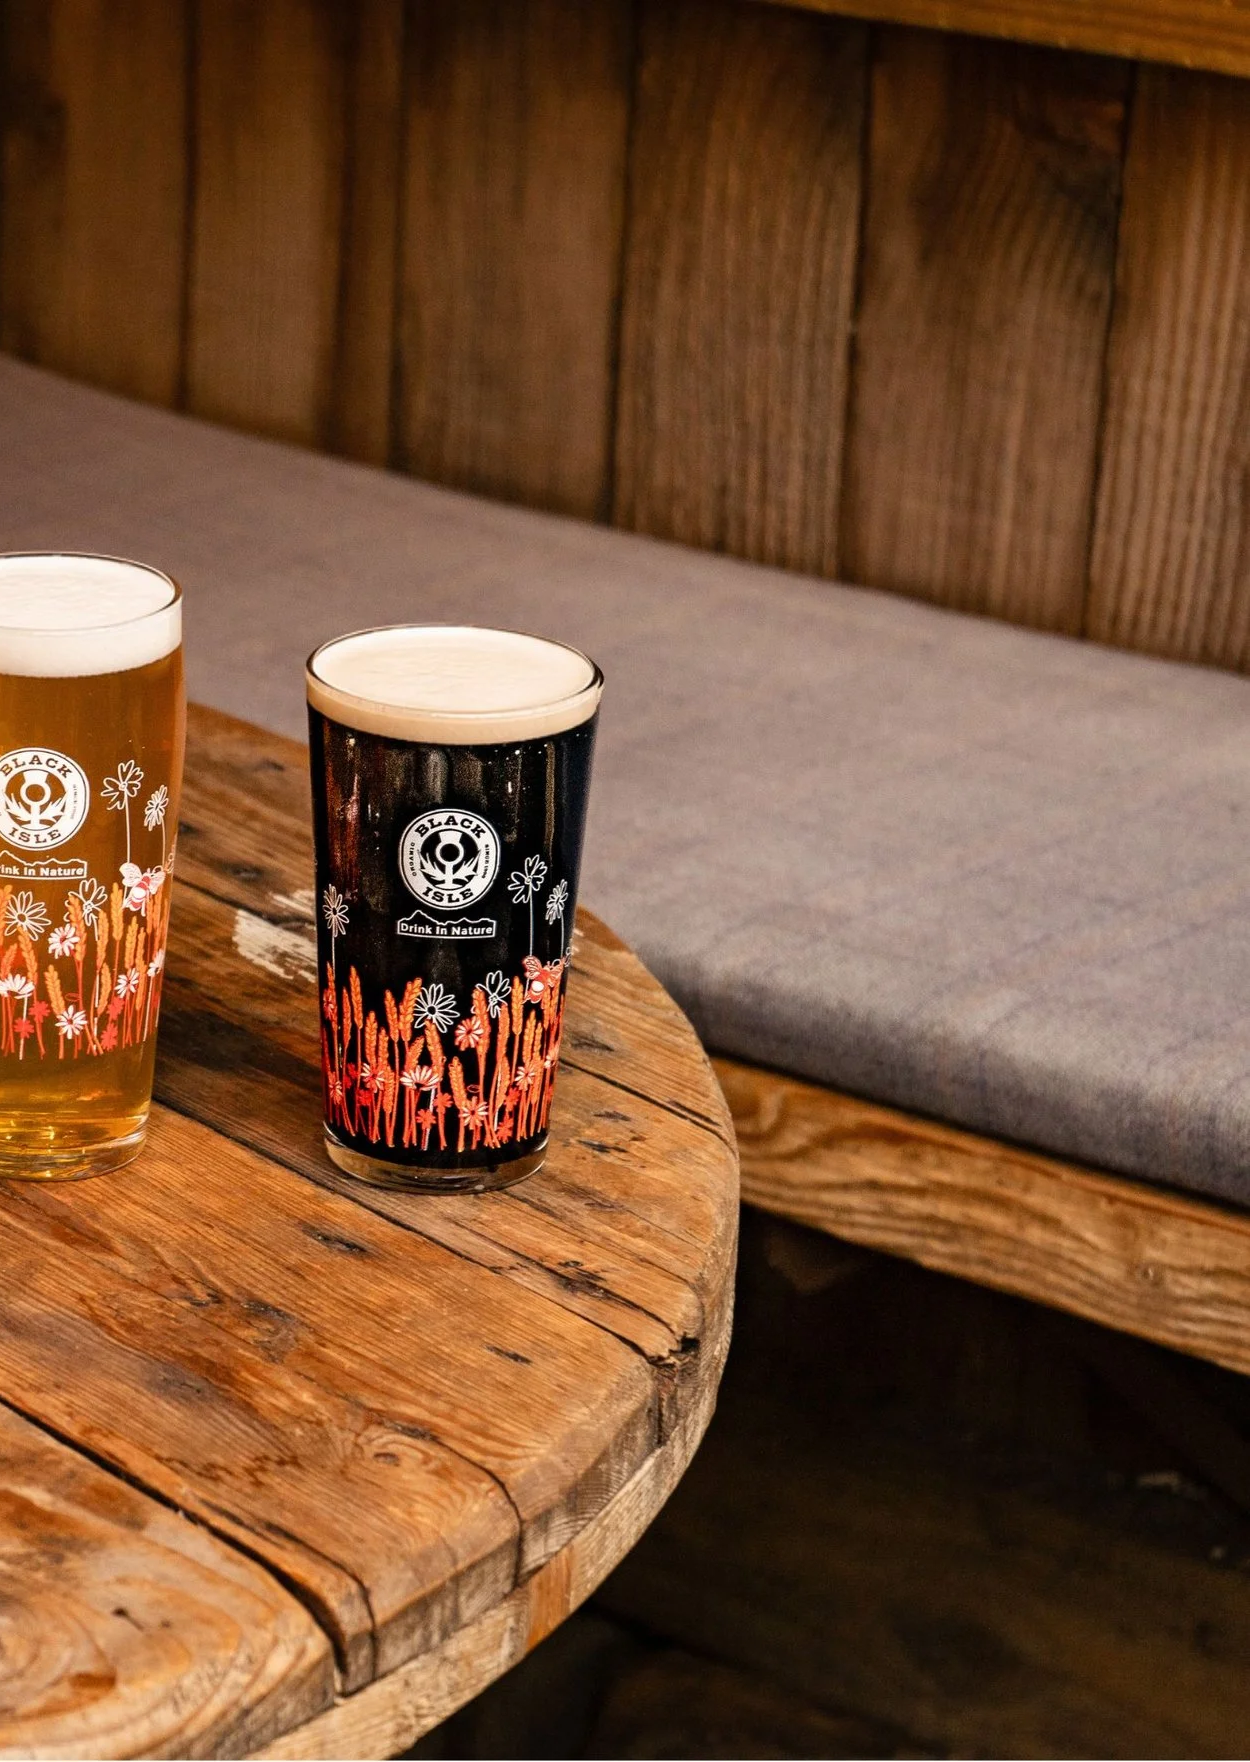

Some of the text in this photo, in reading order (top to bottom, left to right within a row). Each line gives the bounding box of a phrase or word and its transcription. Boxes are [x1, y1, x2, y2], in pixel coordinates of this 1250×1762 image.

[0, 754, 73, 779] BLACK
[9, 826, 62, 844] ISLE
[414, 814, 487, 839] BLACK
[23, 866, 36, 877] In
[40, 866, 84, 878] Nature
[422, 886, 474, 903] ISLE
[400, 922, 493, 937] Drink In Nature
